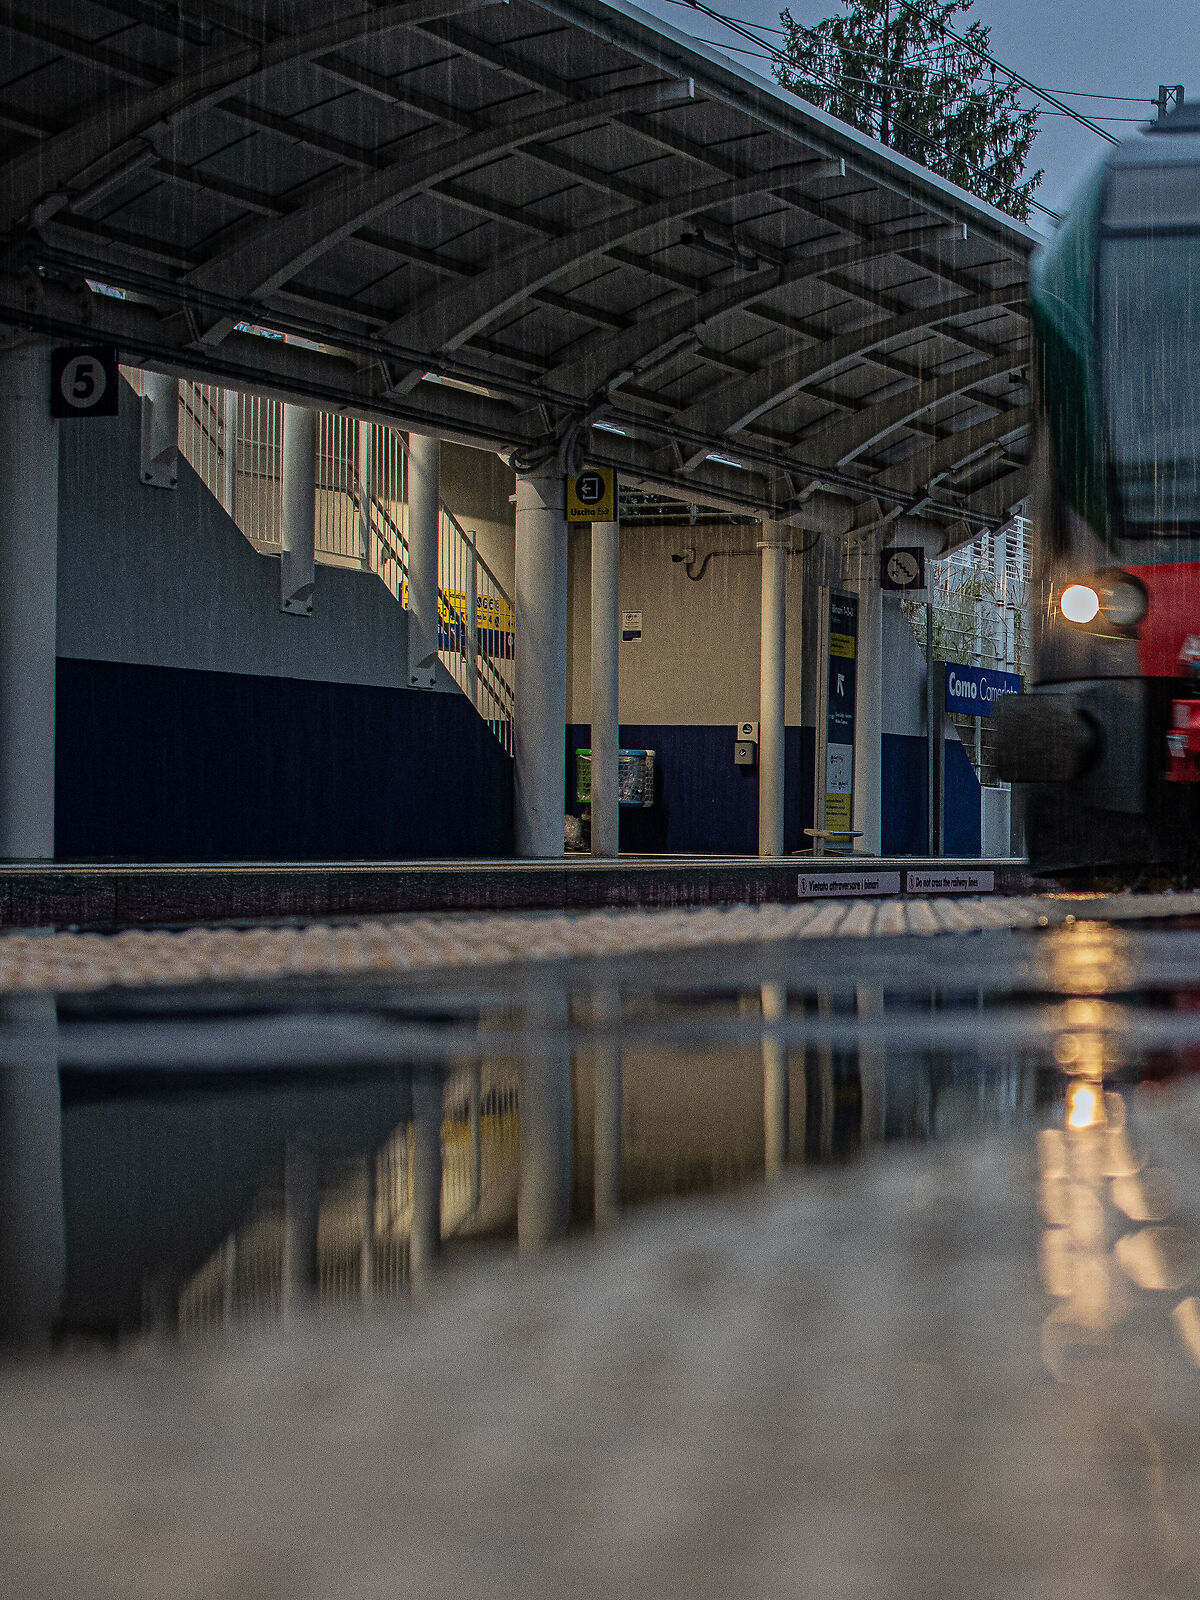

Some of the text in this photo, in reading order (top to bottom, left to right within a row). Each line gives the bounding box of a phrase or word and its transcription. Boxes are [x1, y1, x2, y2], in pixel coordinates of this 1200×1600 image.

[73, 364, 95, 399] 5
[571, 507, 596, 516] Uscita
[948, 671, 977, 700] Como
[808, 880, 829, 892] Vietato
[829, 880, 861, 891] attraversare
[864, 877, 880, 890] binari
[915, 876, 922, 888] Do
